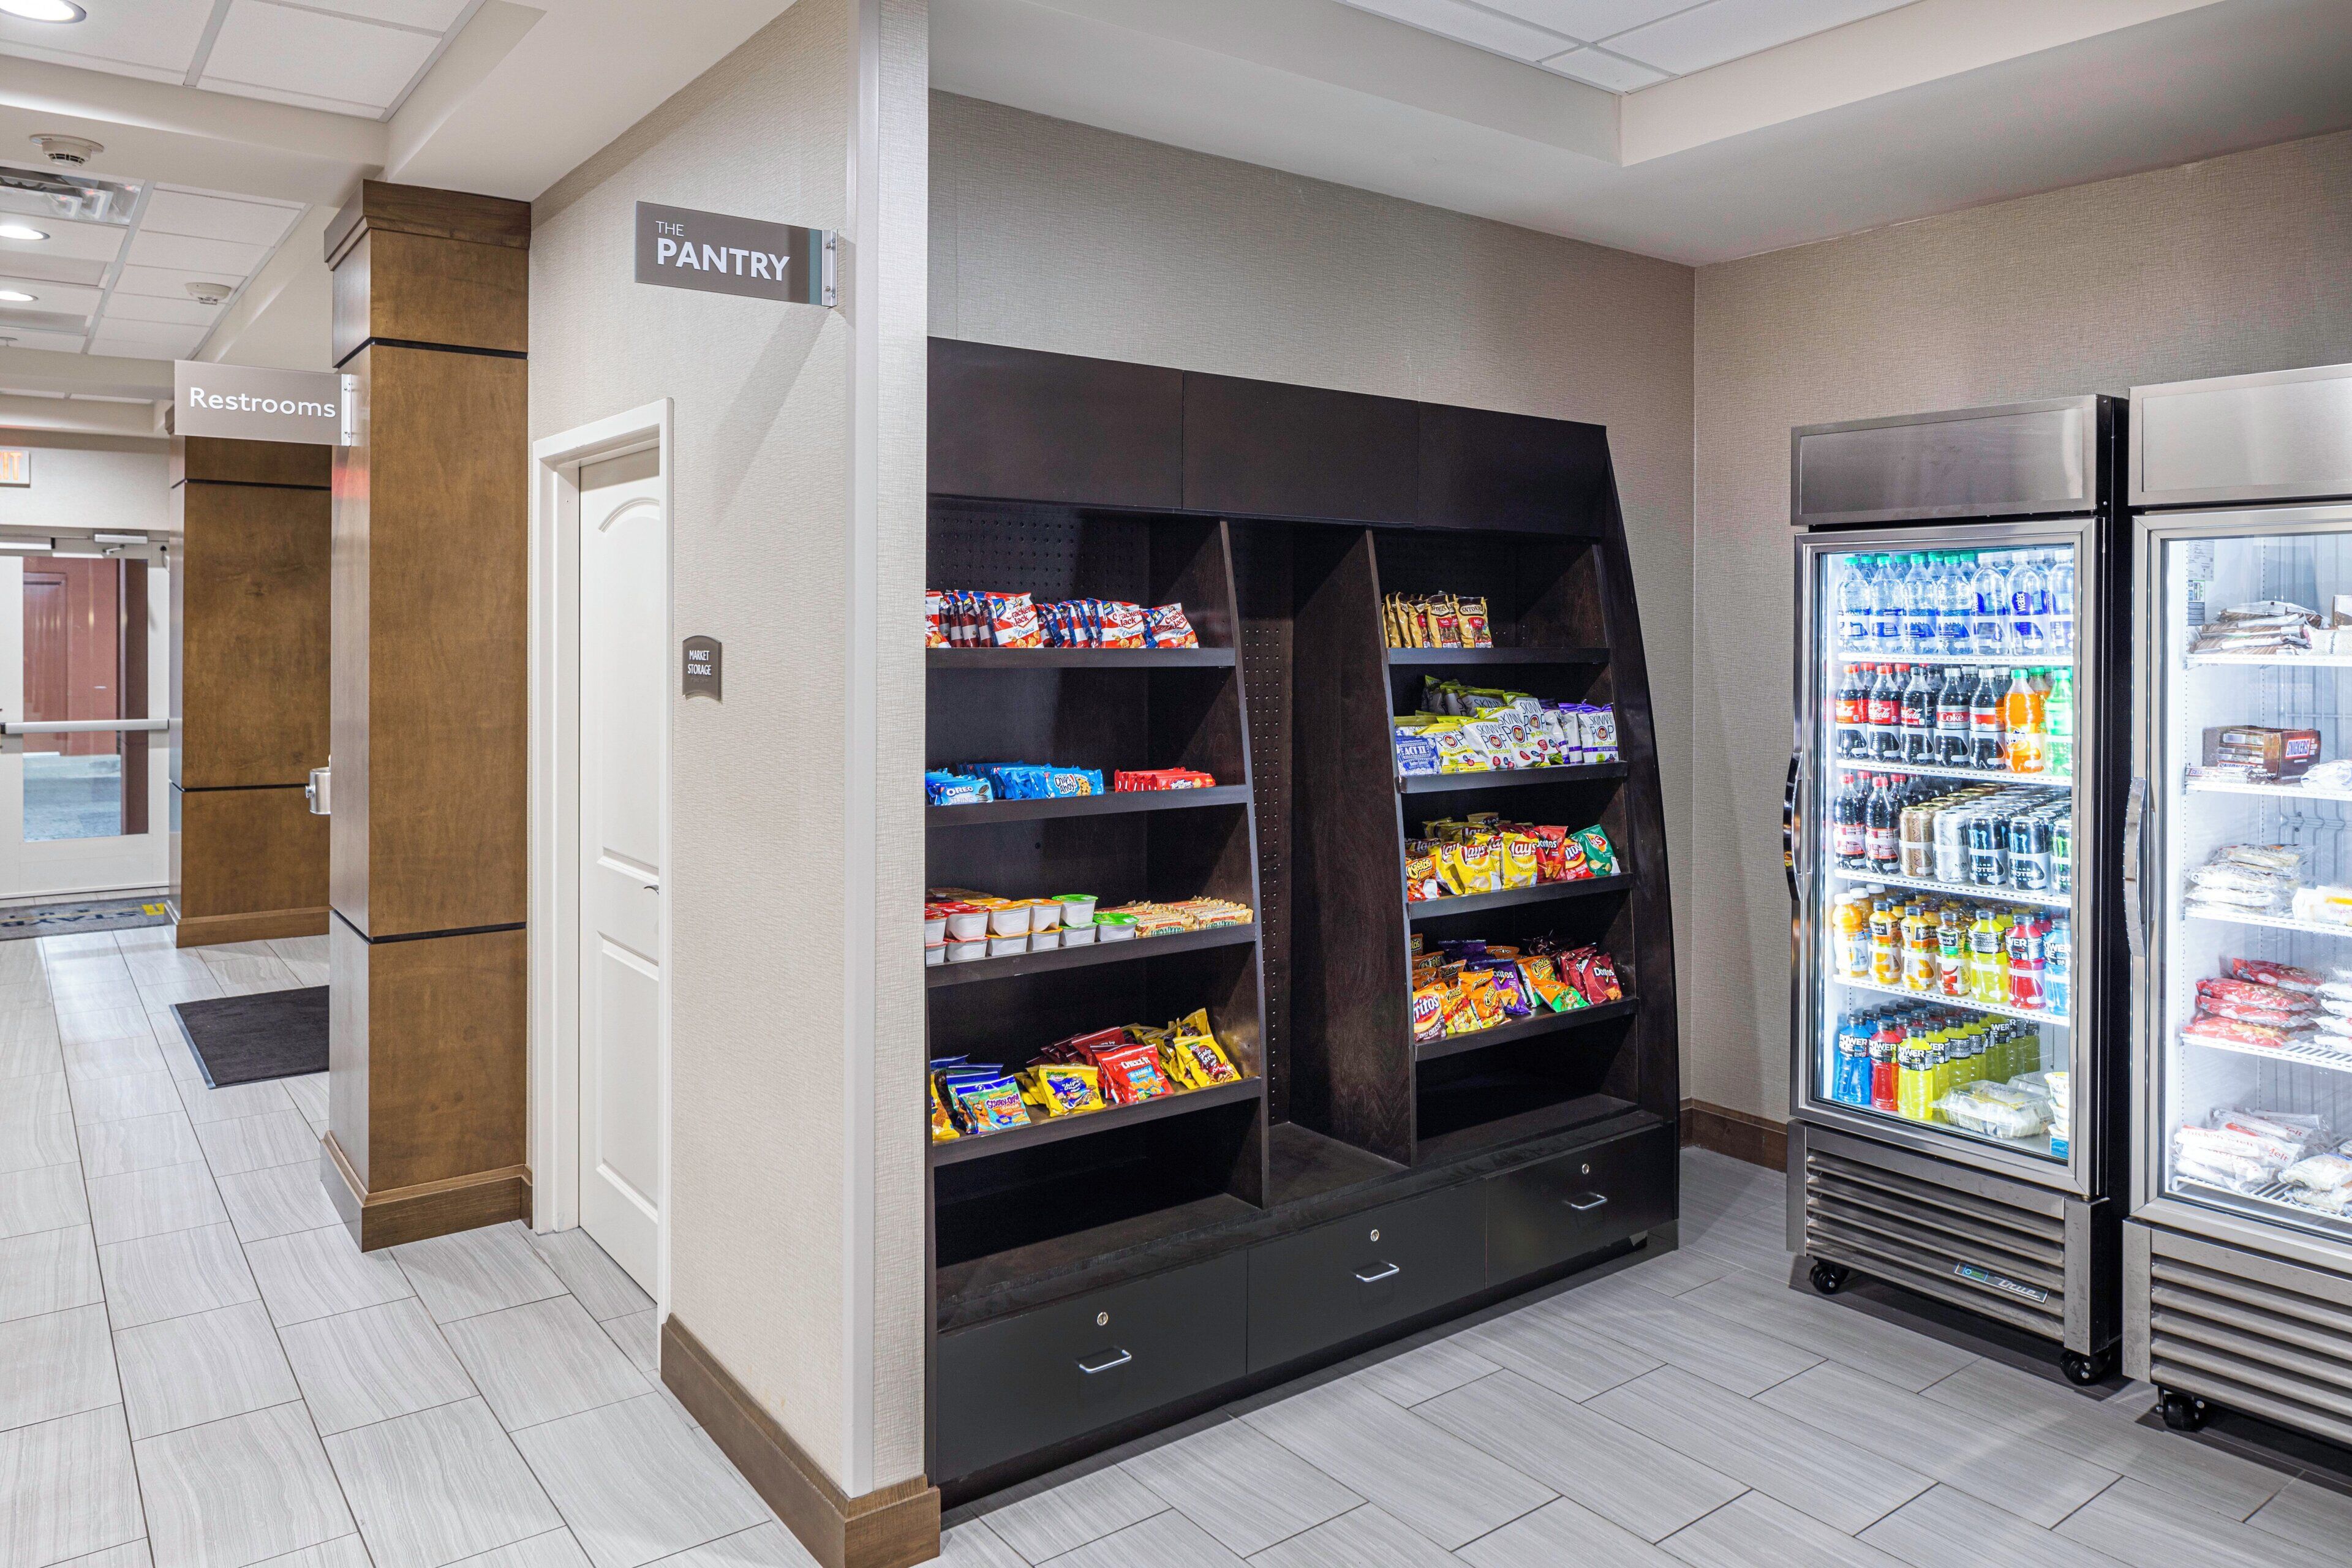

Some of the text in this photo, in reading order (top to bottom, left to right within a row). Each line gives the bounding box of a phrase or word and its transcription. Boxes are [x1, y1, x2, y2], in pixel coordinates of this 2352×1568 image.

[655, 221, 684, 237] THE
[657, 237, 790, 281] PANTRY
[190, 386, 336, 418] Restrooms
[1013, 615, 1029, 627] Jack
[1118, 617, 1136, 628] Jack
[1172, 616, 1187, 629] Jack
[1017, 627, 1035, 637] Original
[1121, 628, 1141, 637] Original
[688, 650, 709, 661] MARKET
[688, 664, 712, 676] STORAGE
[1589, 714, 1612, 725] SKINNY
[1940, 712, 1964, 722] Coke
[1502, 725, 1532, 743] POP
[1590, 725, 1614, 741] POP
[1436, 734, 1464, 748] POP
[1482, 734, 1507, 749] POP
[1404, 747, 1419, 755] ACT
[2287, 740, 2310, 756] SNICKERS
[1055, 776, 1071, 787] Chips
[1170, 779, 1185, 789] Nutter
[946, 786, 974, 796] OREO
[1464, 845, 1488, 861] Lay's
[1512, 842, 1536, 857] Lay's
[1407, 859, 1431, 879] Cheetos
[1532, 958, 1551, 976] Cheetos
[1594, 967, 1615, 977] Doritos
[1446, 987, 1462, 1003] Cheetos
